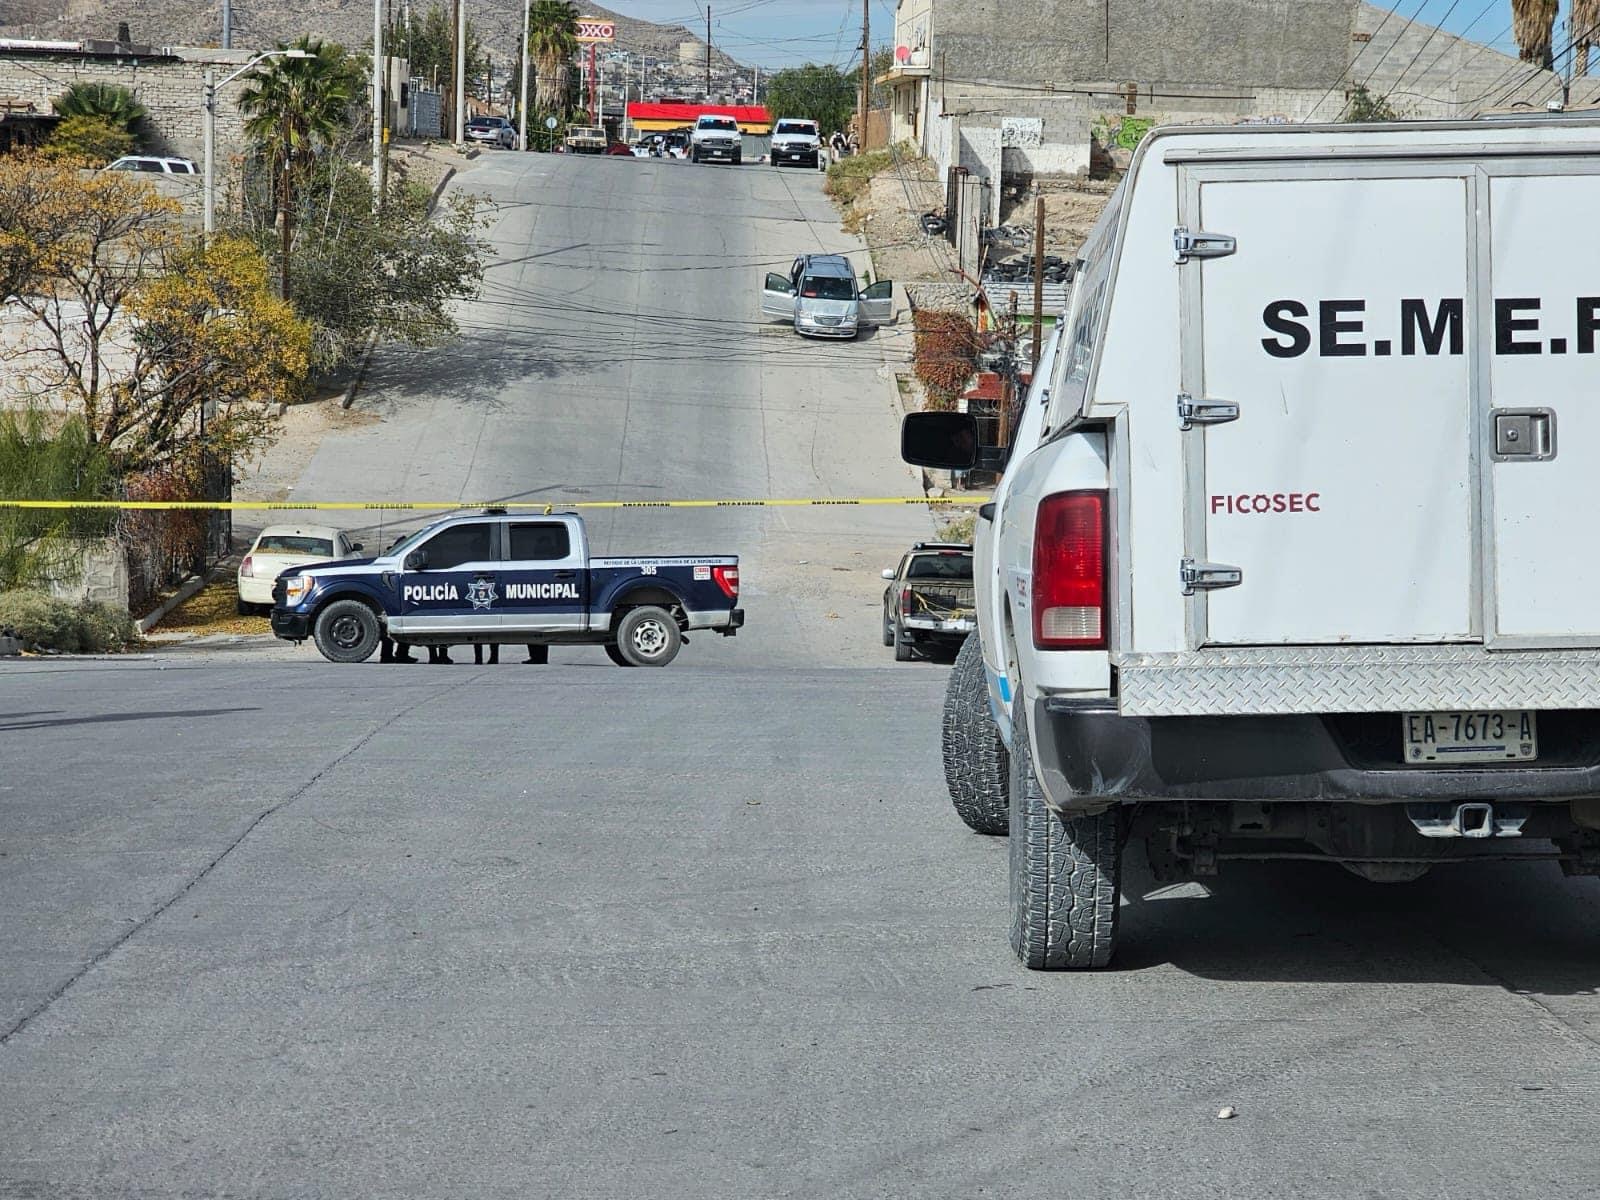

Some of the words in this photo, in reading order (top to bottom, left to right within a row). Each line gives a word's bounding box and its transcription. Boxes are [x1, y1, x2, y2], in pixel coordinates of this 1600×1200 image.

[1211, 493, 1321, 514] FICOSEC
[640, 566, 657, 575] 305
[404, 582, 459, 600] POLICÍA
[506, 583, 579, 599] MUNICIPAL
[1408, 712, 1532, 744] EA-7673-A
